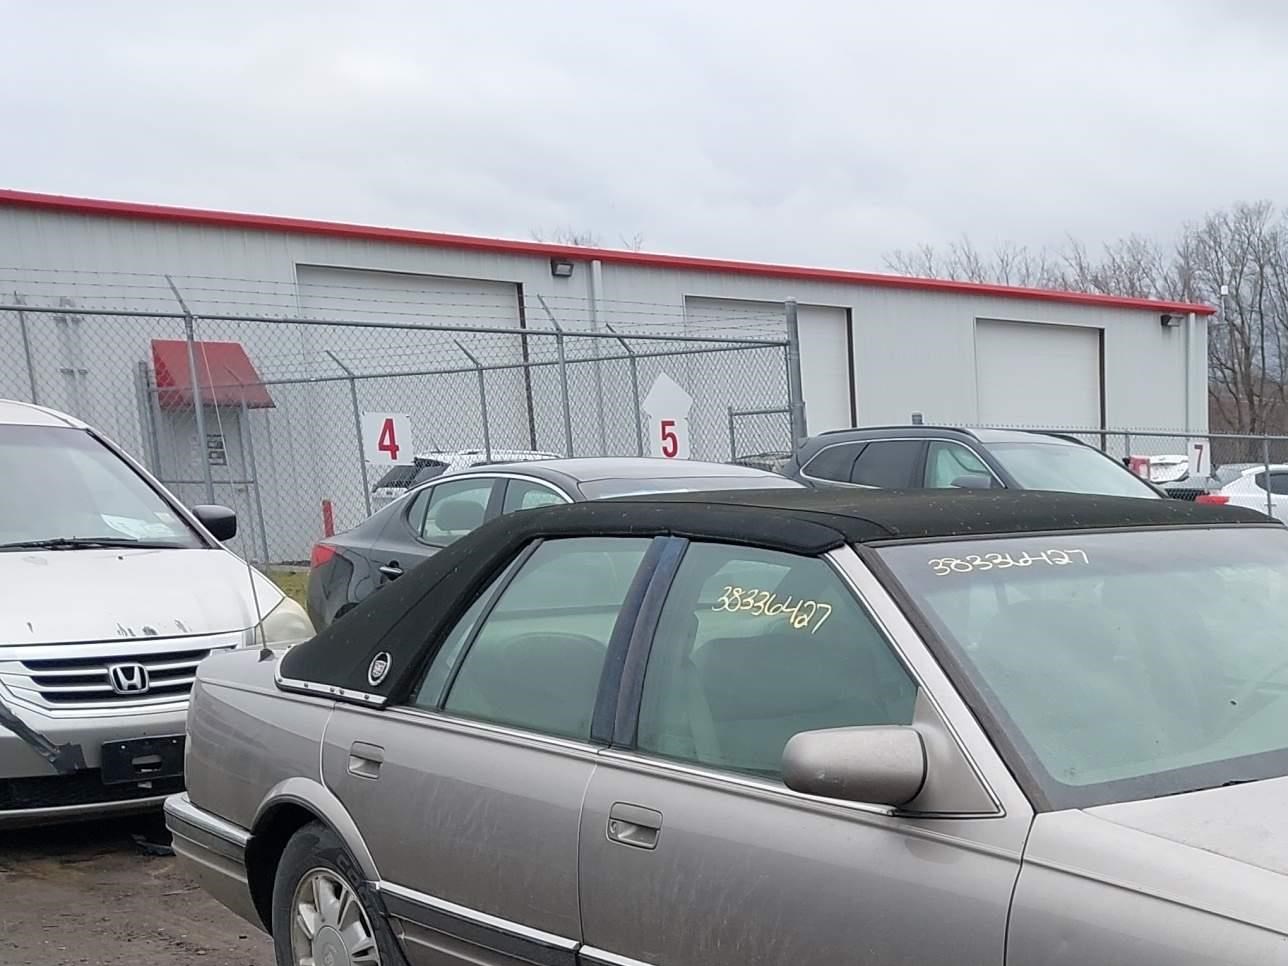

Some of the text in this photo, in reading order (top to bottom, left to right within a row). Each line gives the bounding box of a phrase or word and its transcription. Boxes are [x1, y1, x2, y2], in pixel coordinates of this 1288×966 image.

[378, 418, 399, 460] 4
[661, 420, 678, 458] 5
[1194, 444, 1203, 473] 7
[928, 549, 1089, 576] 38336427
[711, 586, 832, 635] 38336427
